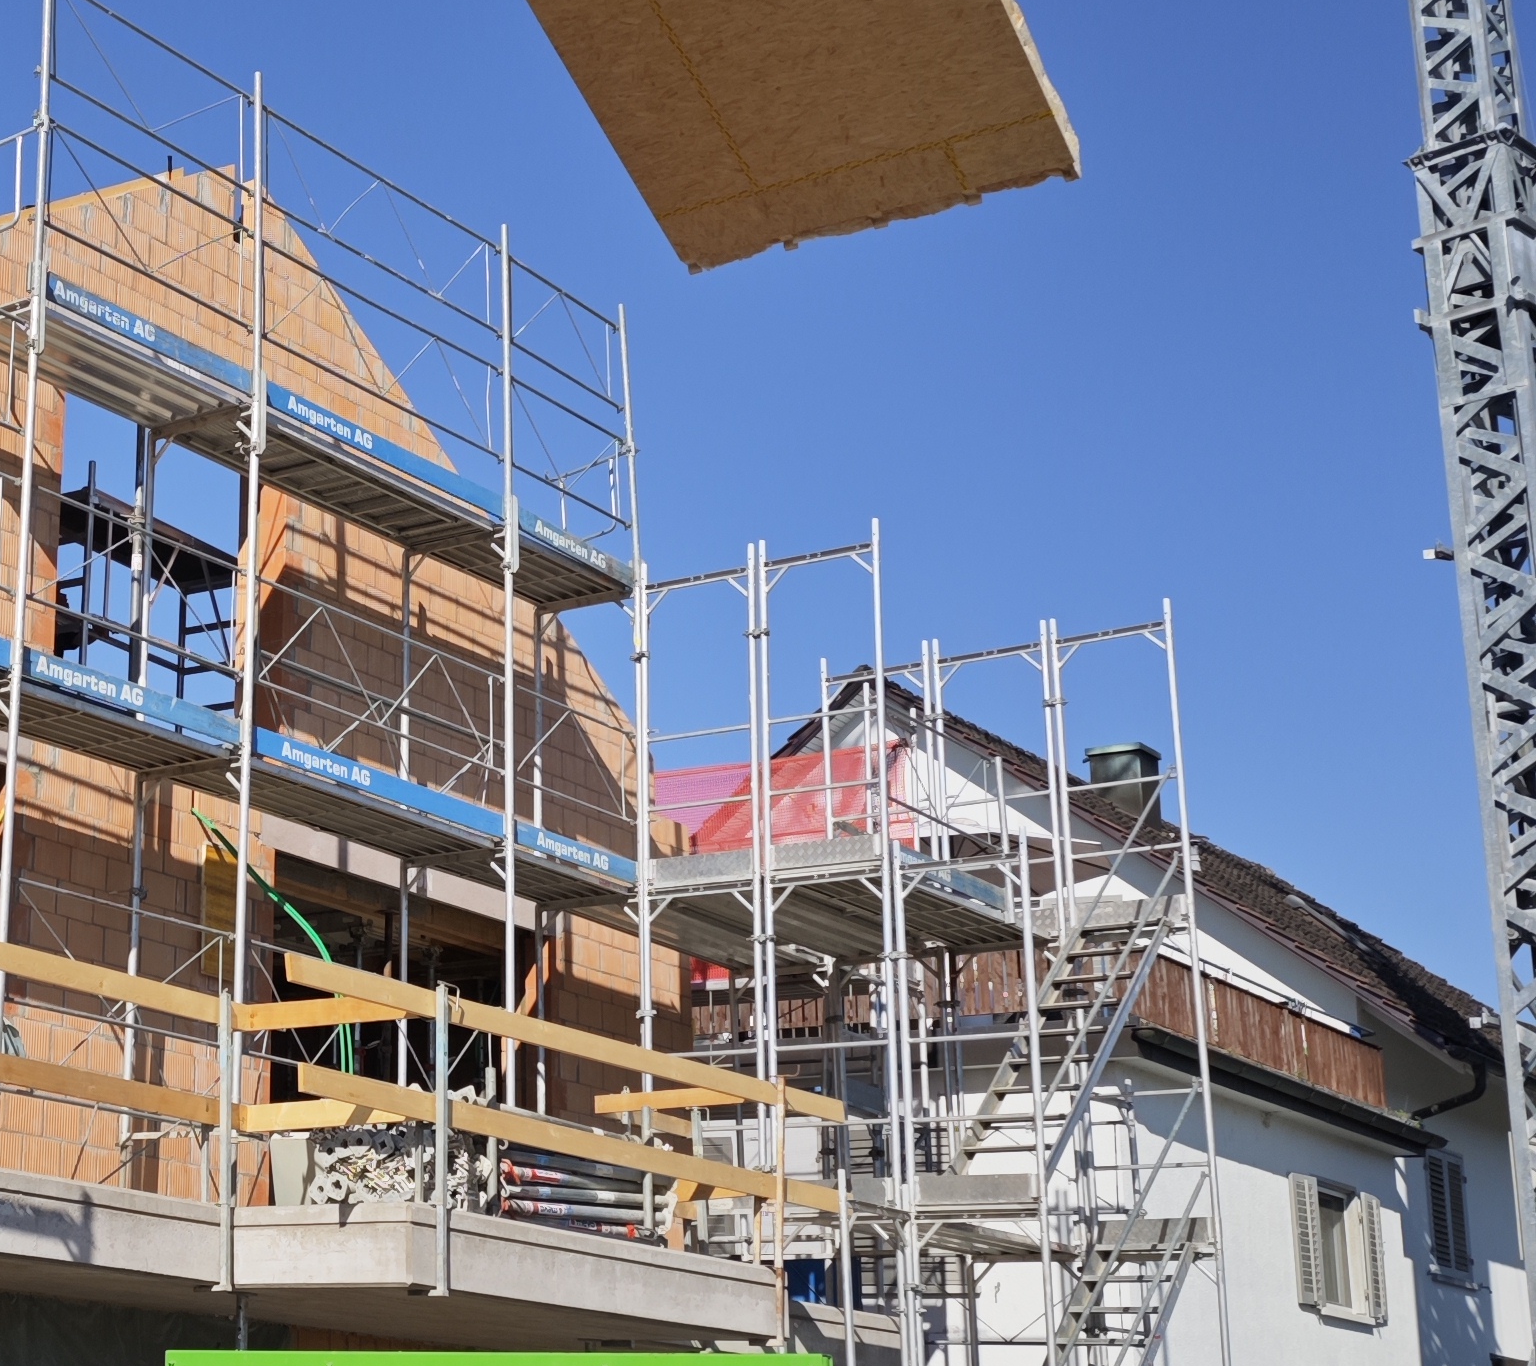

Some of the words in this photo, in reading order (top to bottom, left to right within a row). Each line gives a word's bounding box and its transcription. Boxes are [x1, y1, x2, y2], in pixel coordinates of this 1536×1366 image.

[54, 280, 129, 330] Amgarten
[133, 319, 156, 342] AG
[287, 395, 351, 439] Amgarten
[354, 428, 373, 449] AG
[534, 519, 588, 559] Amgarten
[590, 549, 607, 569] AG
[35, 655, 117, 697] Amgarten
[119, 684, 144, 707] AG
[281, 741, 348, 779] Amgarten
[351, 766, 371, 786] AG
[537, 831, 591, 864] Amgarten
[593, 852, 609, 871] AG
